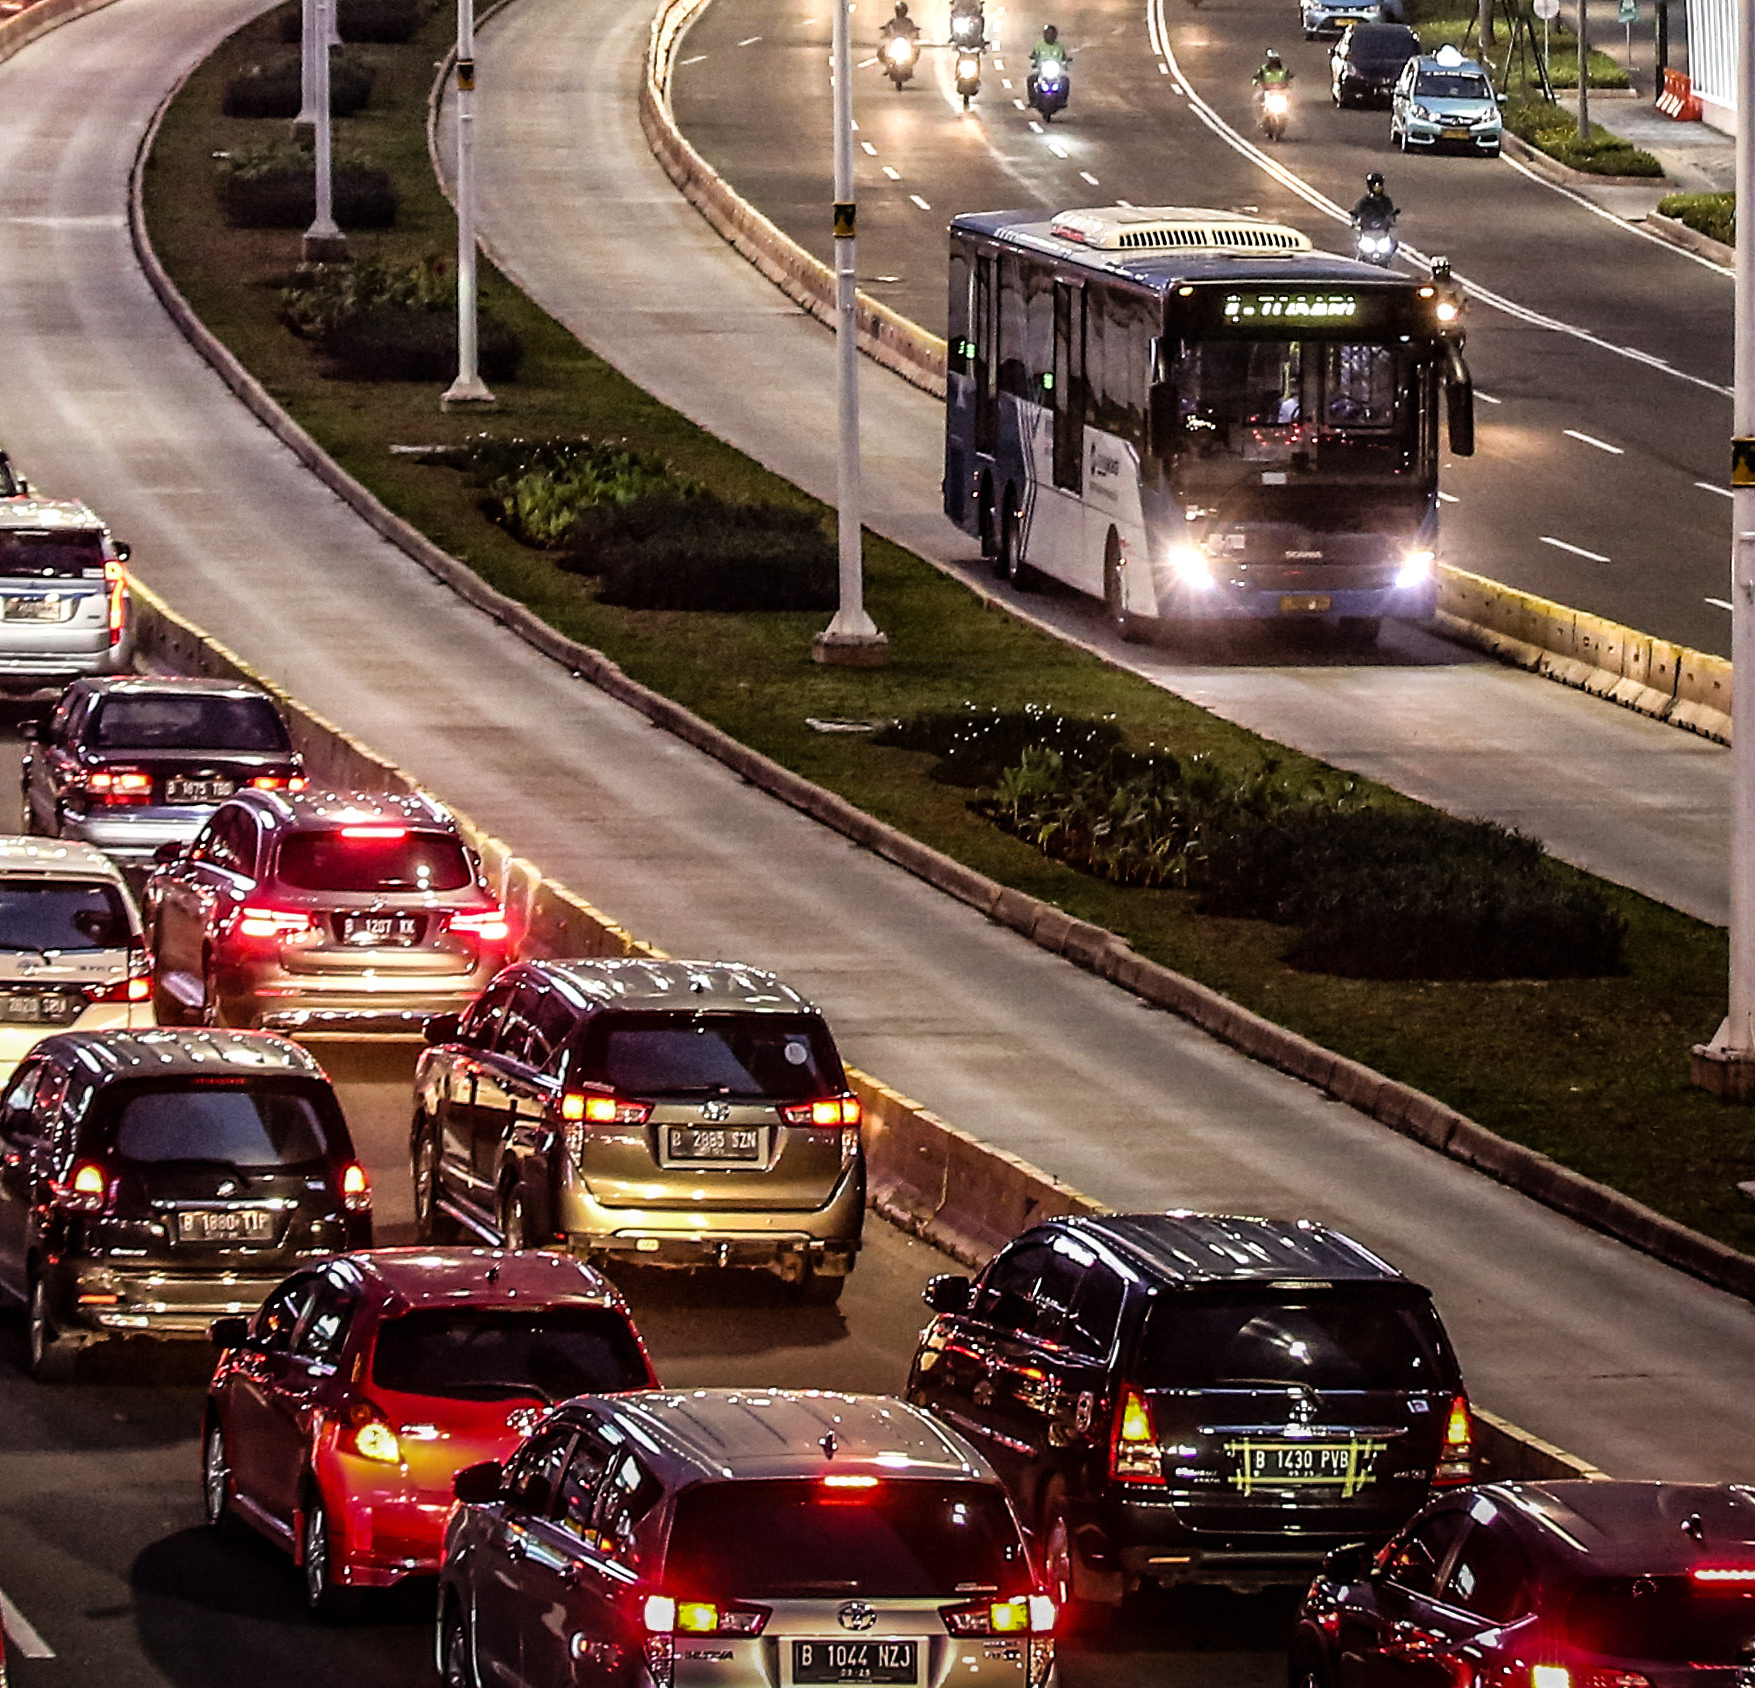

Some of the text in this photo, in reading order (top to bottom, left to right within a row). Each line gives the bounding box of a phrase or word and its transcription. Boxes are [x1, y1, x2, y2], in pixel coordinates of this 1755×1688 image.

[1256, 1450, 1349, 1469] B 1430 PVB
[802, 1645, 910, 1667] B 1044 NZJ
